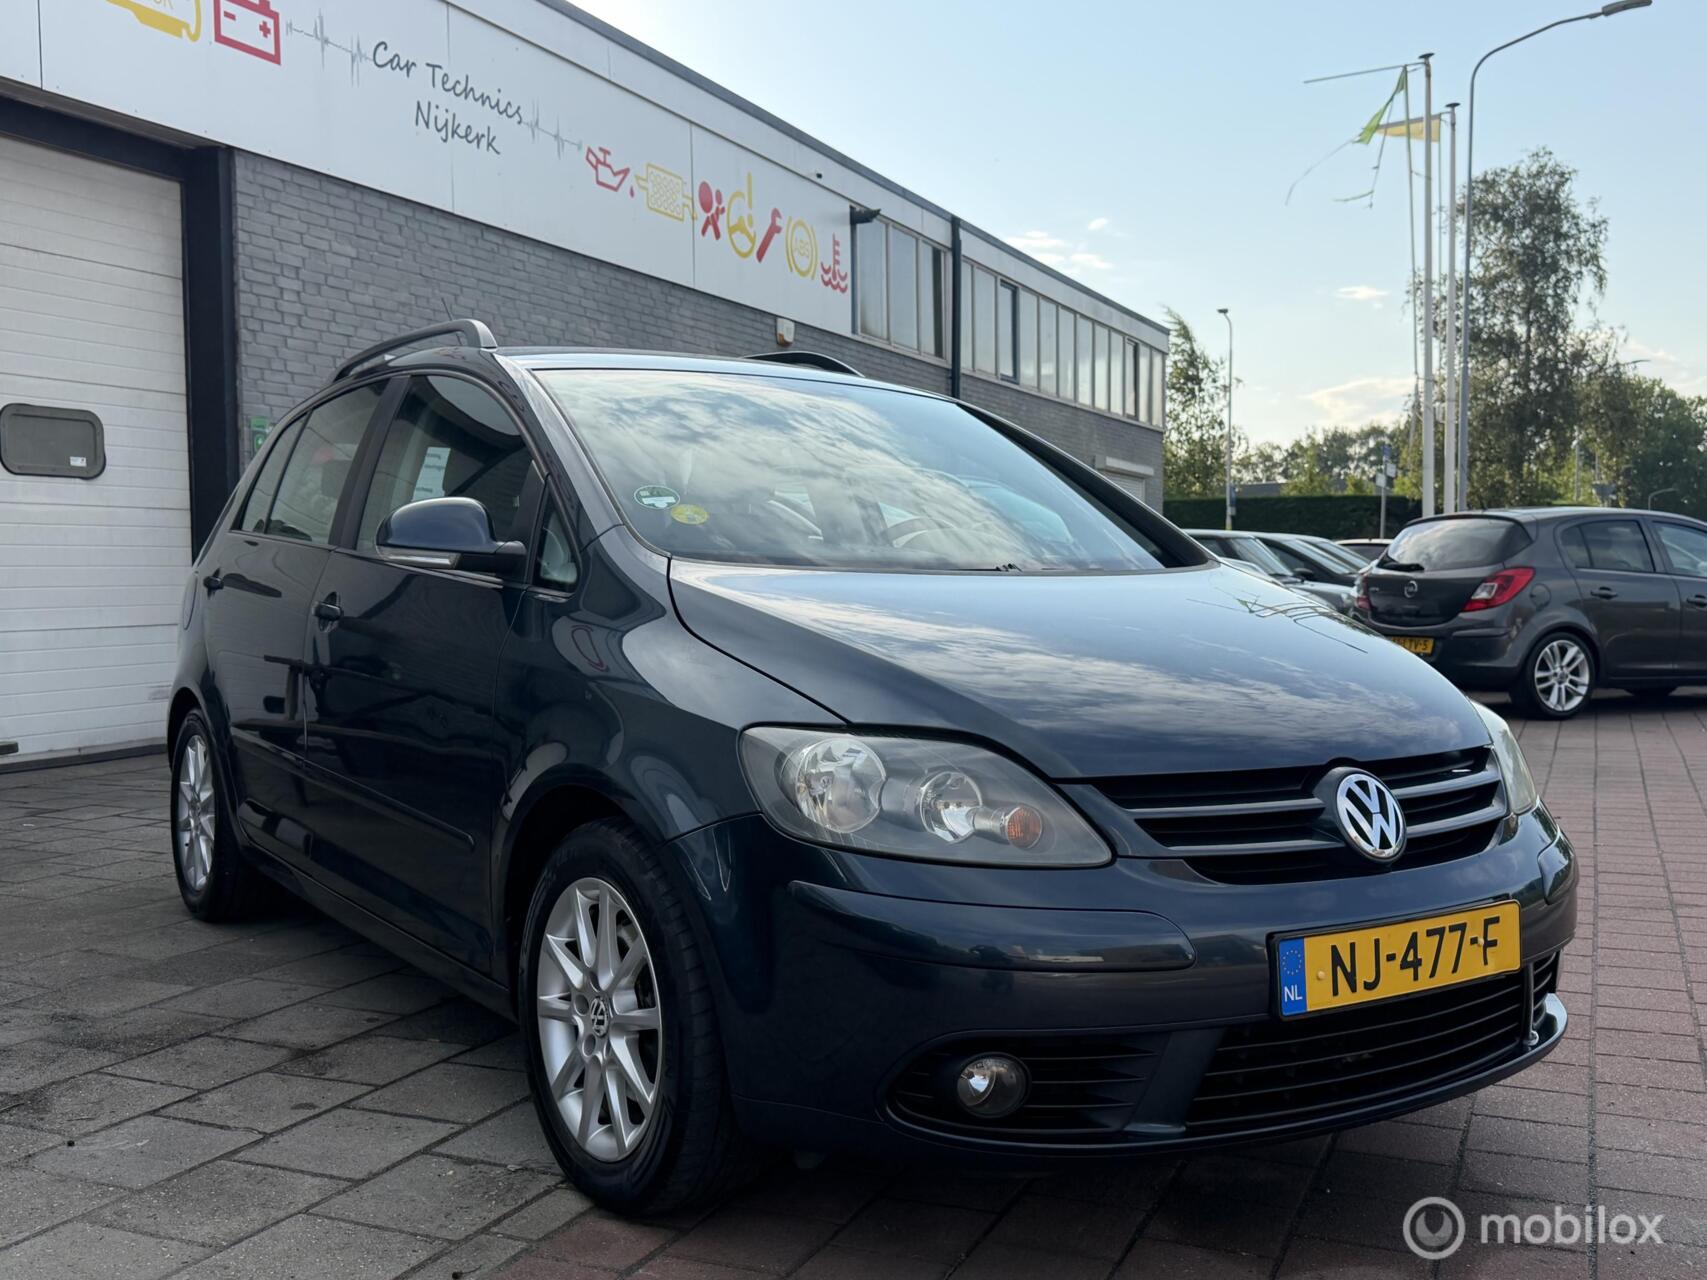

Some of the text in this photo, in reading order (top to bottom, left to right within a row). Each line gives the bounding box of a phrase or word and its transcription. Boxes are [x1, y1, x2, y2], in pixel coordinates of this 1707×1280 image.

[373, 41, 523, 125] Car Technics
[415, 100, 501, 155] Nijkerk
[1331, 916, 1500, 997] NJ-477-F
[1284, 985, 1303, 1003] NL
